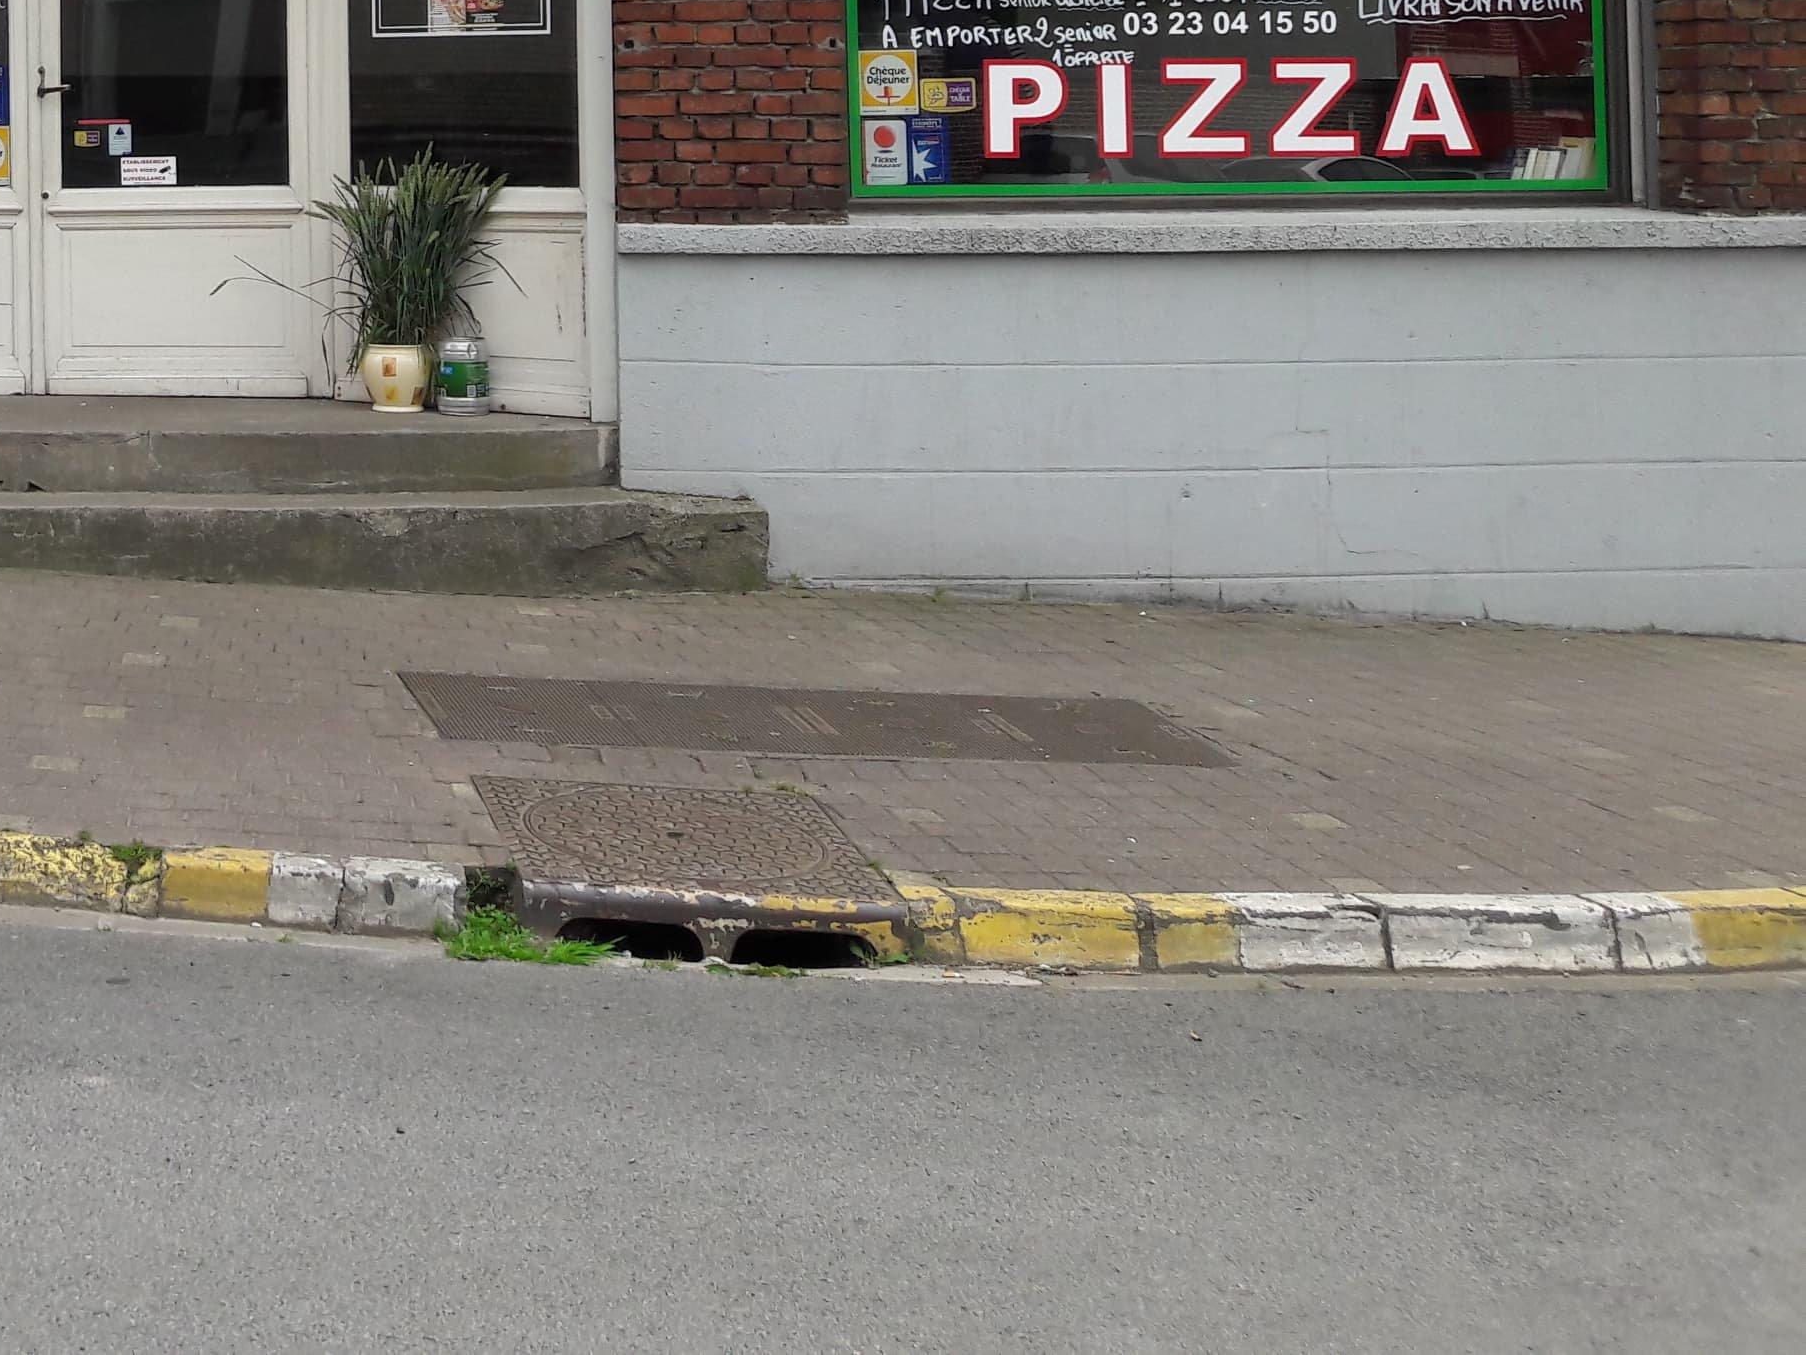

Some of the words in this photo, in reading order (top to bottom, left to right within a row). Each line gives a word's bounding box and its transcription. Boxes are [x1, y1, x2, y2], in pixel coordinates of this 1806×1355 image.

[882, 24, 898, 48] A
[909, 26, 1032, 48] EMPORTER
[1034, 16, 1054, 48] 2
[1122, 11, 1158, 35] 03
[1168, 11, 1203, 35] 23
[1213, 11, 1248, 35] 04
[1259, 11, 1292, 34] 15
[1303, 10, 1337, 34] 50
[866, 75, 910, 86] Déjeuner
[869, 66, 907, 76] Chèque
[983, 56, 1481, 159] PIZZA
